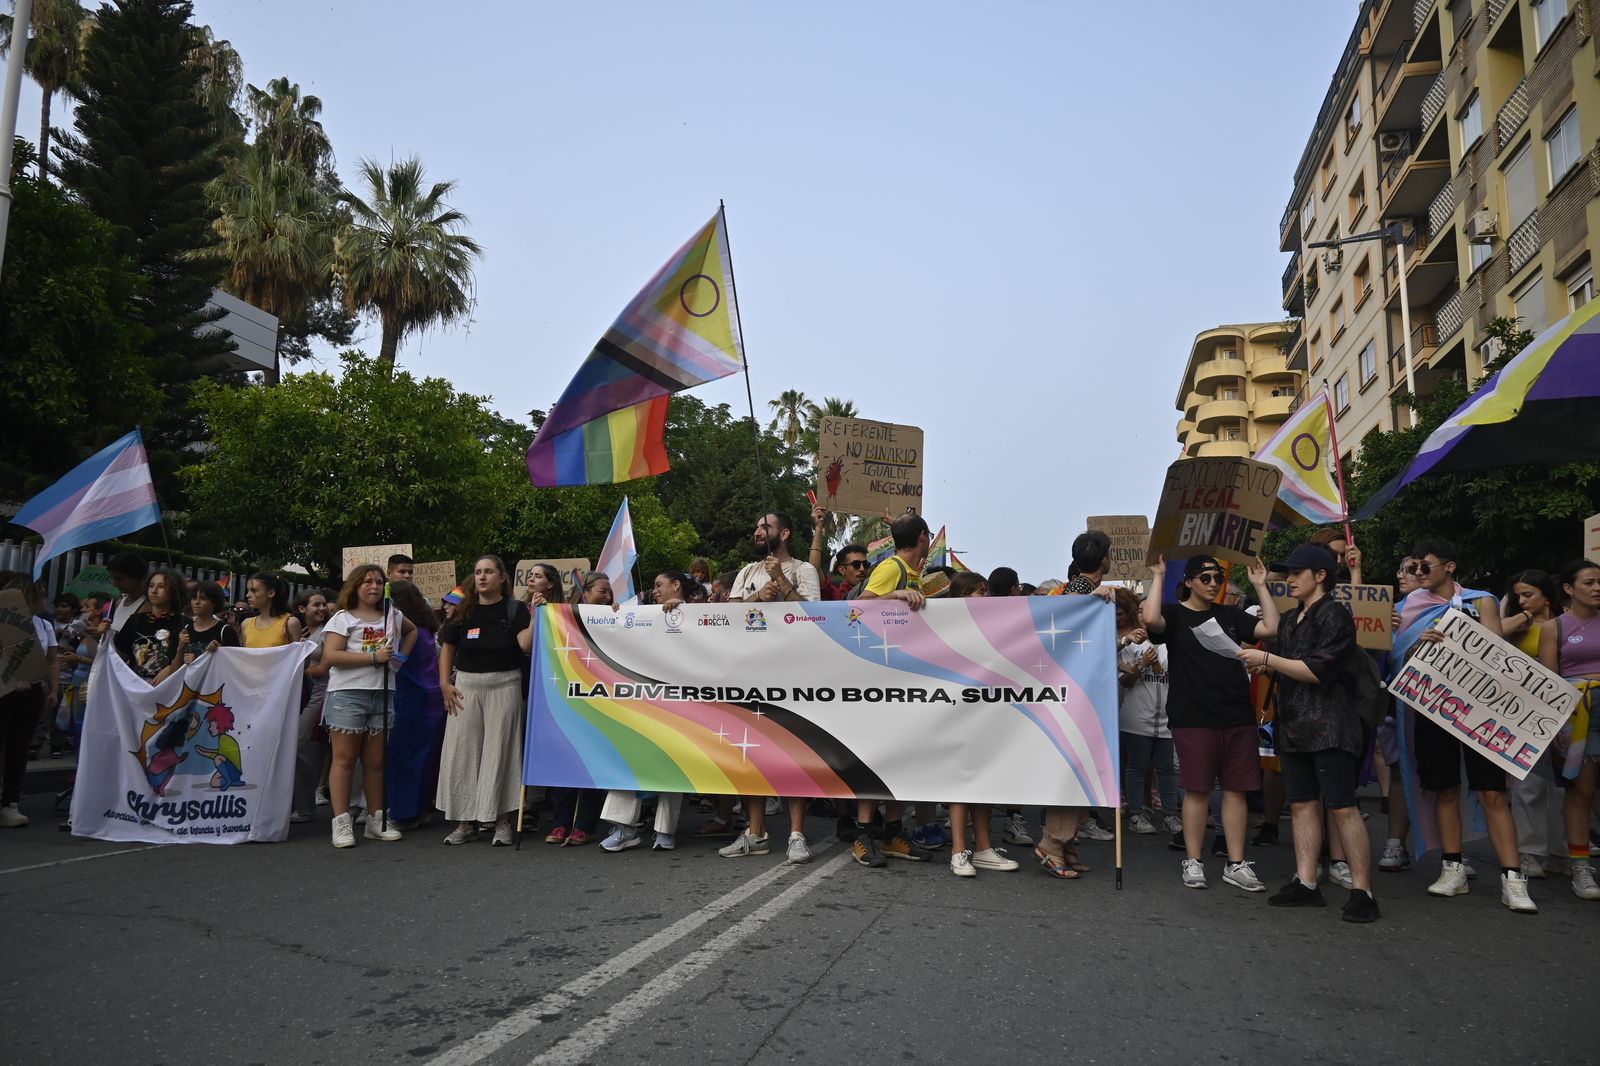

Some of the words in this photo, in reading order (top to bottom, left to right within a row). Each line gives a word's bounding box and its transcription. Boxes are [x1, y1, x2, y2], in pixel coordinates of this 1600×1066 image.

[823, 420, 898, 443] REFERENTE
[846, 442, 862, 459] NO
[864, 443, 917, 465] BINARIO
[870, 480, 923, 497] NECESARIO
[1179, 488, 1241, 511] LEGAL
[1179, 512, 1265, 557] BINARIE
[587, 616, 616, 625] Huelva
[796, 614, 826, 623] triángulo
[1442, 616, 1573, 715] NUESTRA
[568, 683, 609, 697] ¡LA
[614, 683, 788, 702] DIVERSIDAD
[792, 687, 836, 702] NO
[841, 687, 957, 706] BORRA,
[961, 686, 1068, 703] SUMA!
[1393, 665, 1540, 771] INVIOLABLE
[176, 827, 188, 836] de
[216, 828, 221, 837] y
